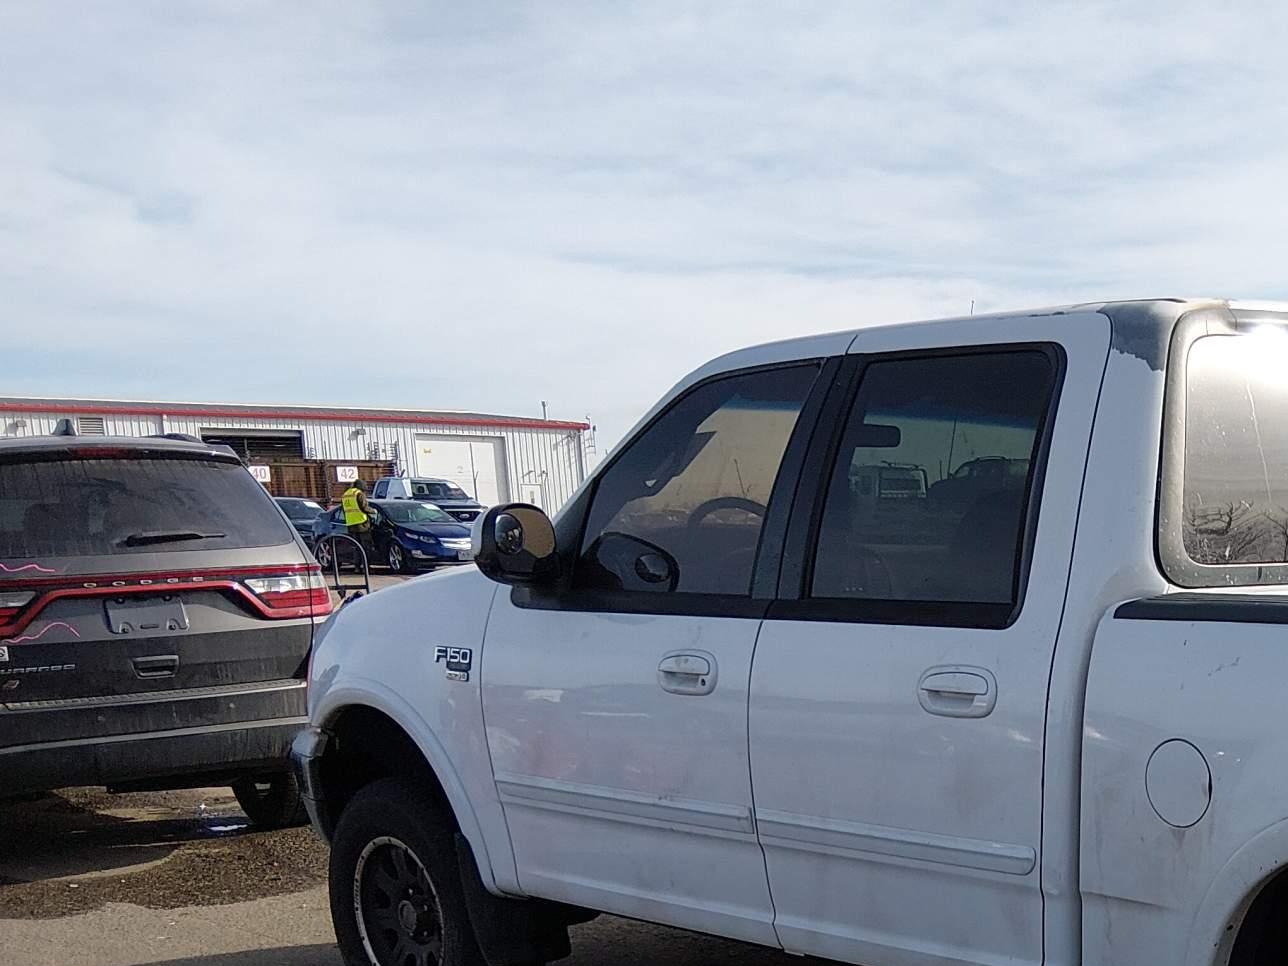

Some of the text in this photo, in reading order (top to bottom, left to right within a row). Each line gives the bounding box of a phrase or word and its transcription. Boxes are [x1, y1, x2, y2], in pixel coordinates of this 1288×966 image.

[340, 468, 355, 480] 42
[83, 576, 204, 589] DODGE
[434, 646, 470, 664] F150
